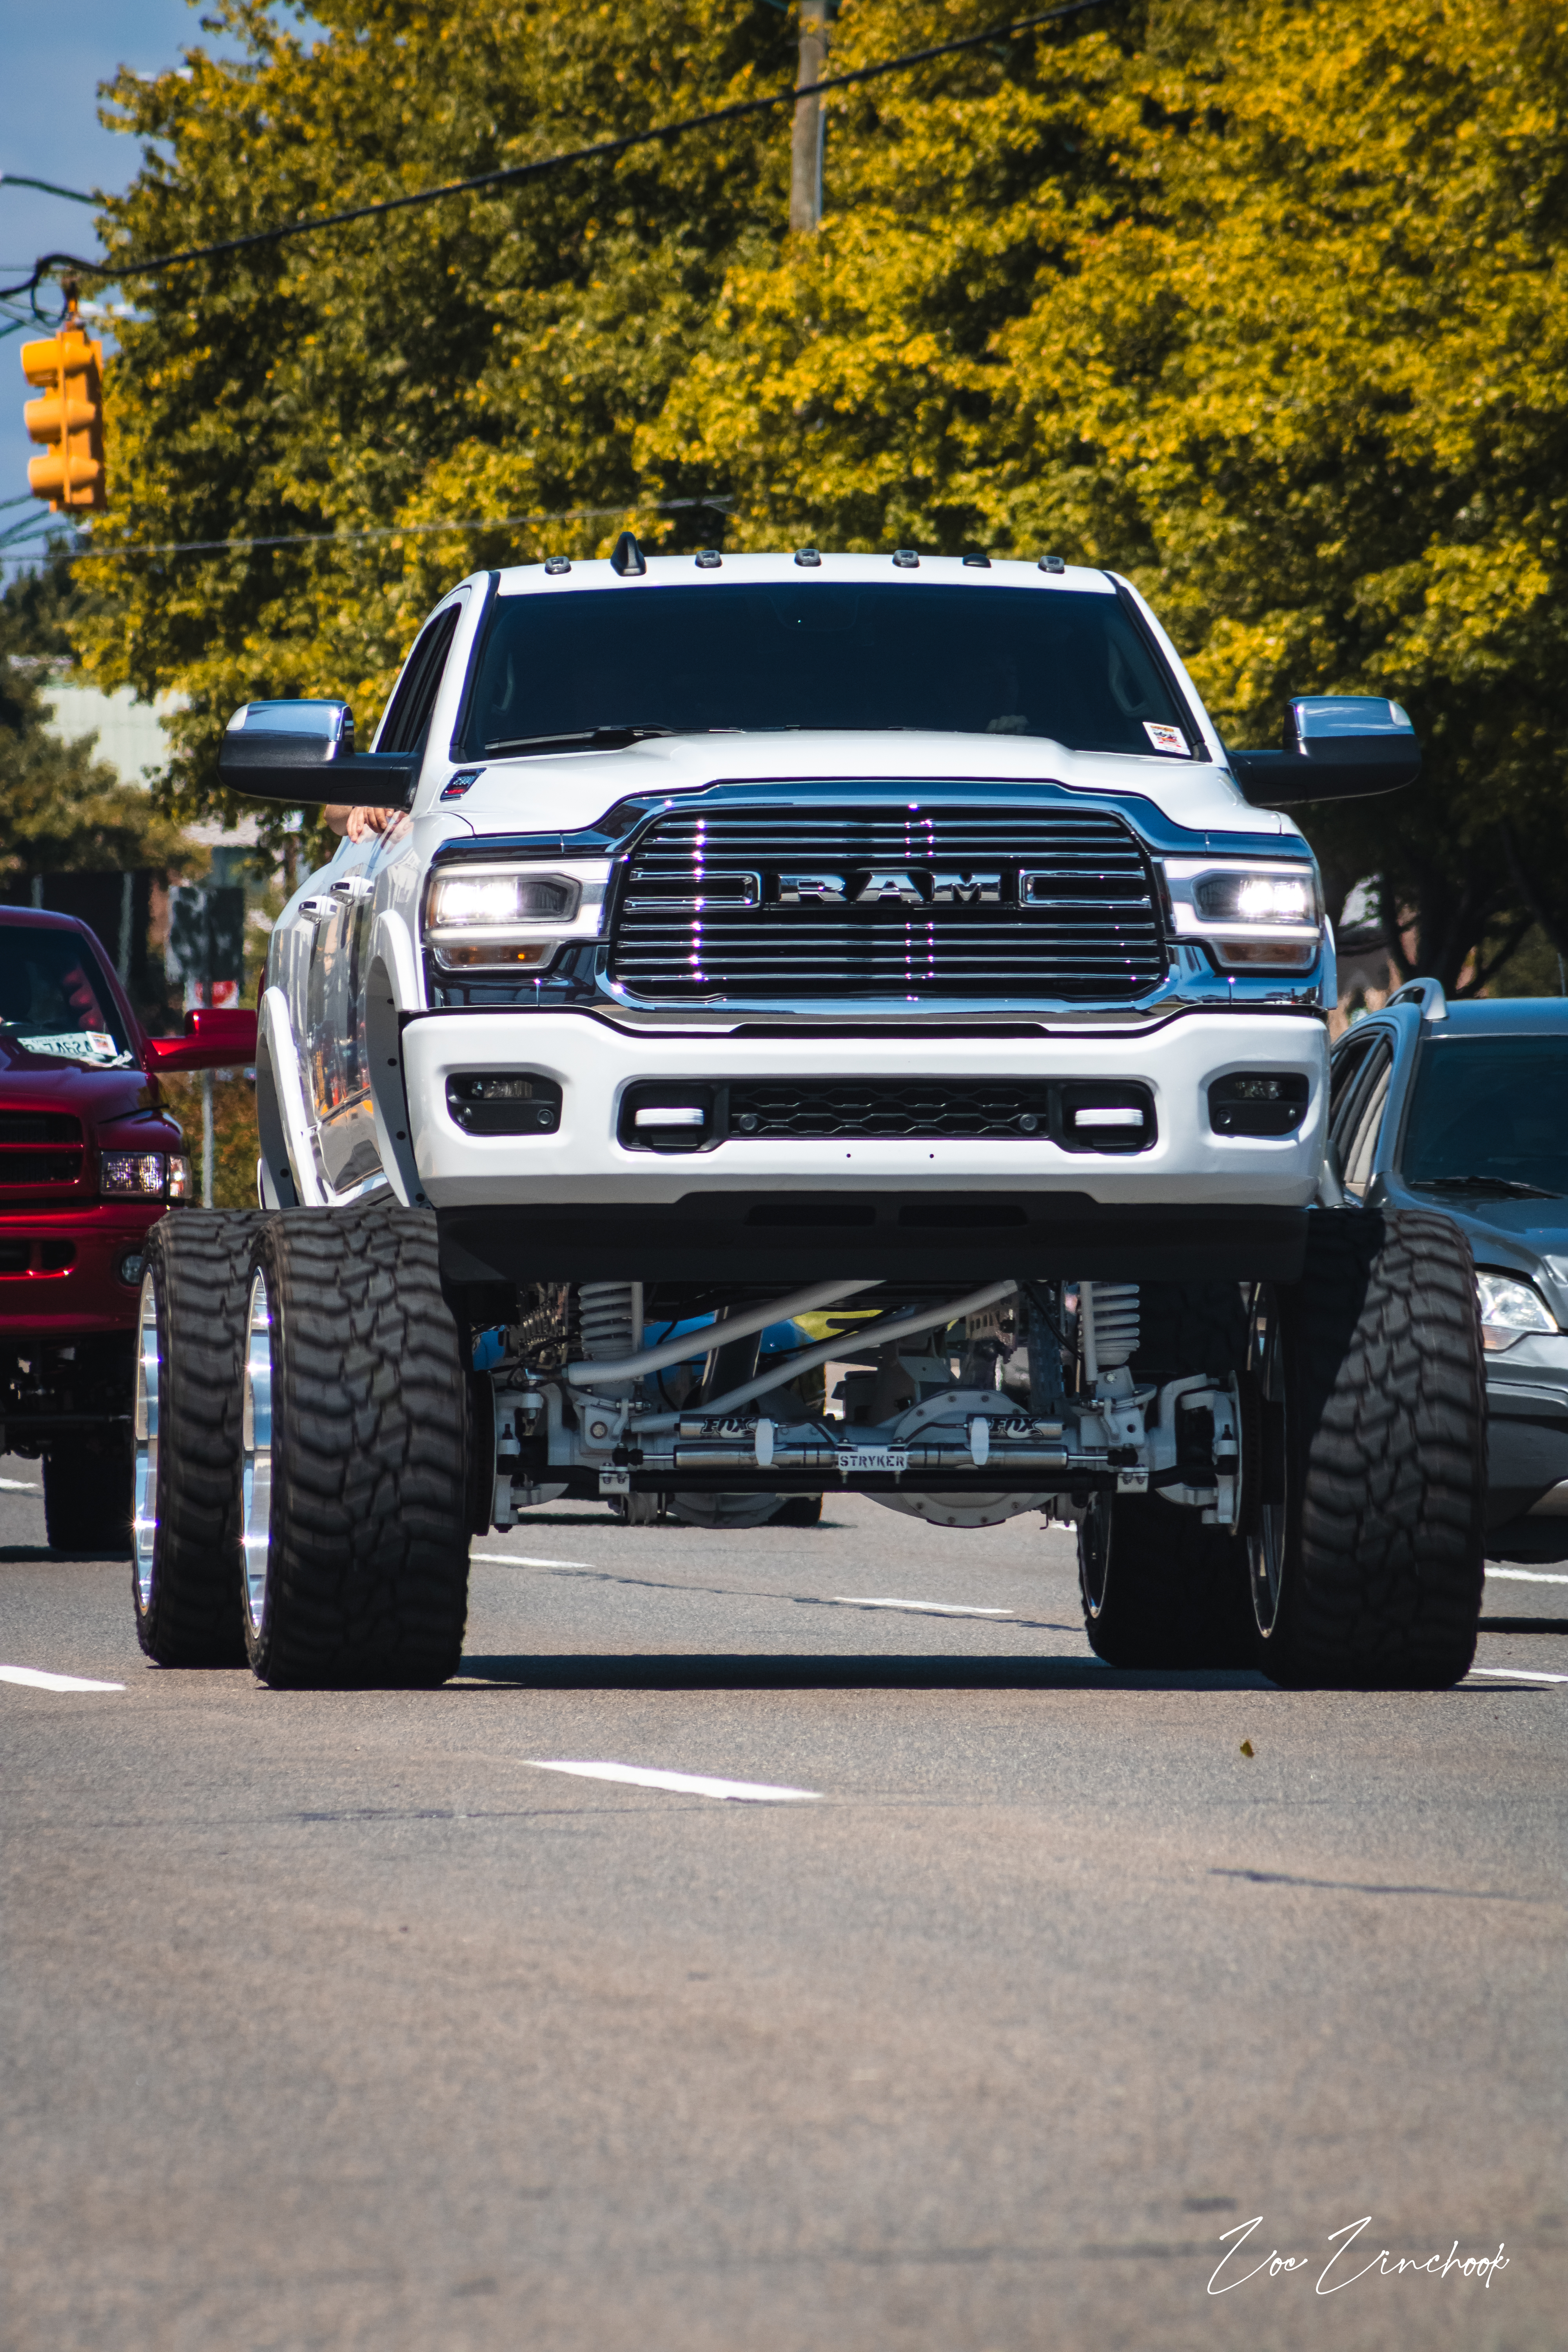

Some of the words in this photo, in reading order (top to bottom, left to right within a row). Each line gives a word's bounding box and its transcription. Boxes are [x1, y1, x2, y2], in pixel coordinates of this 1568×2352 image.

[778, 872, 1001, 901] RAM
[700, 1417, 756, 1435] FOX
[989, 1417, 1042, 1435] FOX
[840, 1455, 905, 1468] STRYKER
